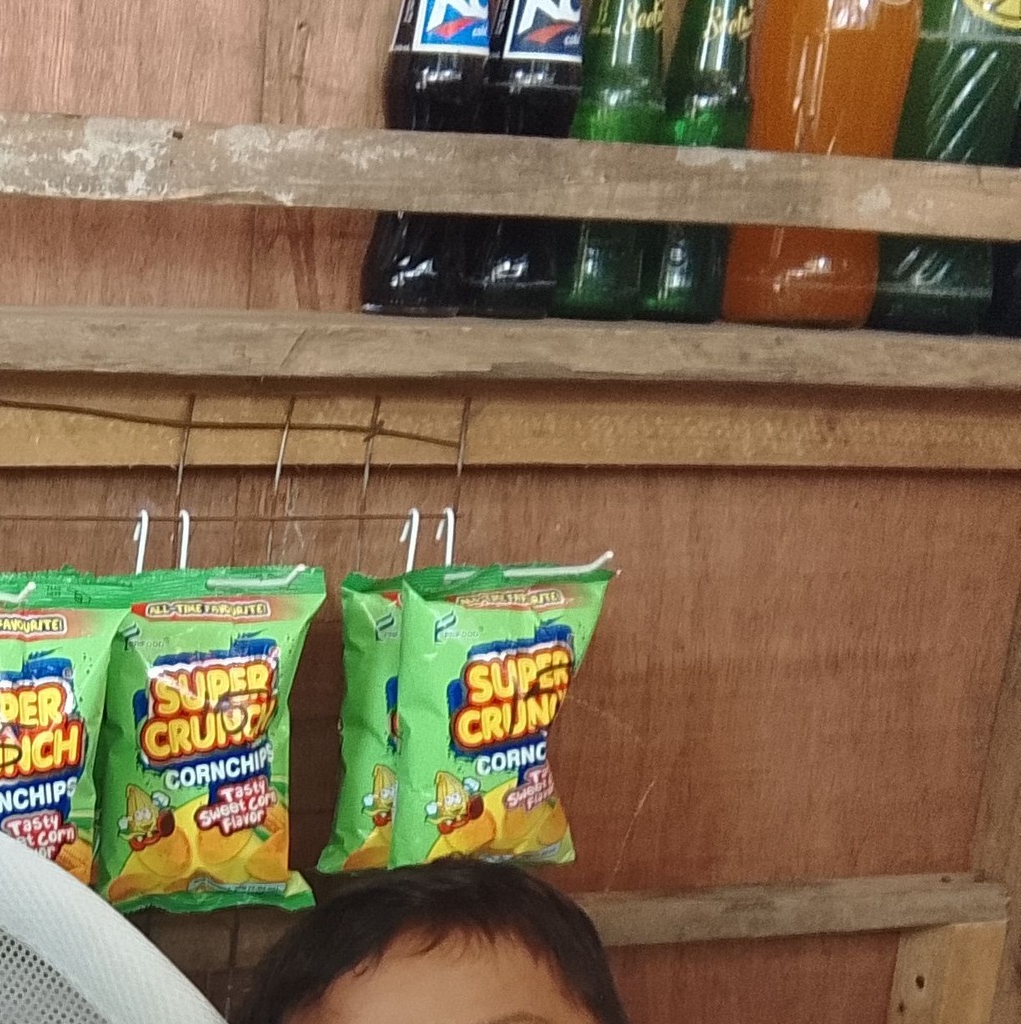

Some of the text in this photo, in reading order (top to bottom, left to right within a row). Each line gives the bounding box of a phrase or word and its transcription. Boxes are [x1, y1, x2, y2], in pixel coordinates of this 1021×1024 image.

[154, 663, 270, 716] SUPER
[468, 650, 570, 704] SUPER
[144, 697, 278, 758] CRUNCH
[165, 742, 274, 790] CORNCHIPS
[219, 777, 266, 804] Tasty
[6, 813, 59, 838] Tasty
[198, 797, 247, 829] Sweet
[221, 809, 265, 835] Flavor
[37, 826, 75, 847] Corn
